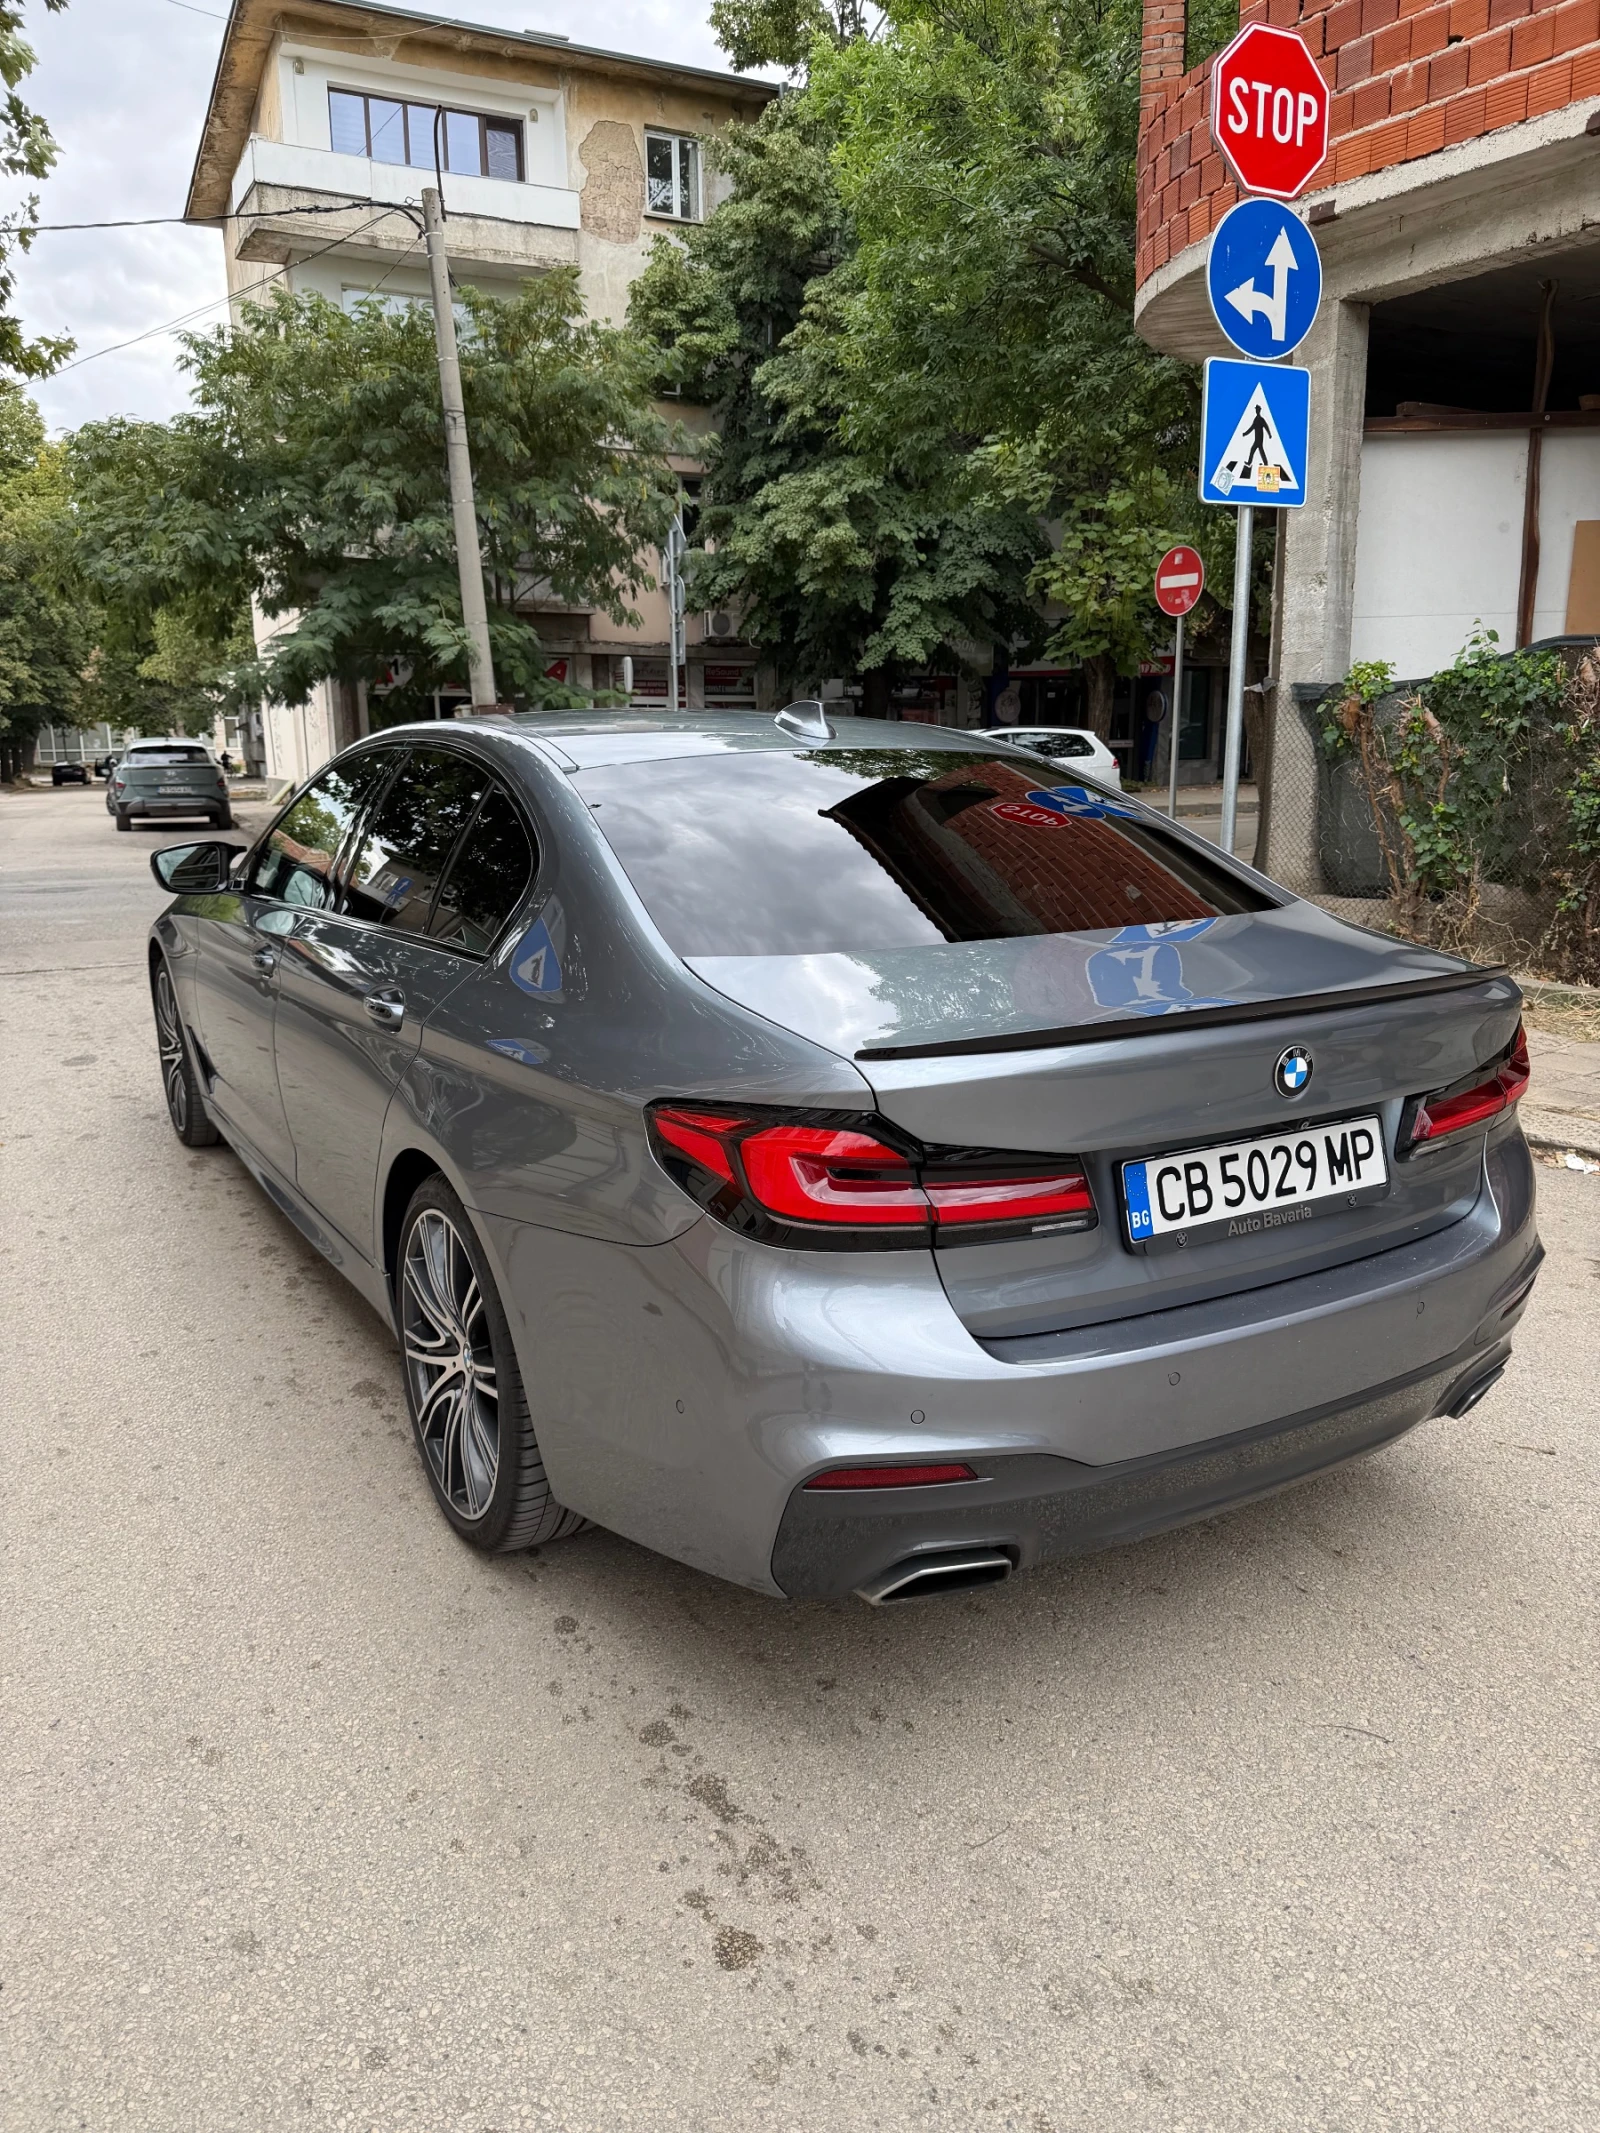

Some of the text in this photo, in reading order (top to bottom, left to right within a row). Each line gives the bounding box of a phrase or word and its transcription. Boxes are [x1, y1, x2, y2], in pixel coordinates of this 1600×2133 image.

[1227, 76, 1319, 147] STOP
[1156, 1128, 1374, 1221] CB 5029 MP
[1131, 1209, 1150, 1229] BG
[1228, 1204, 1313, 1237] Auto Bavaria
